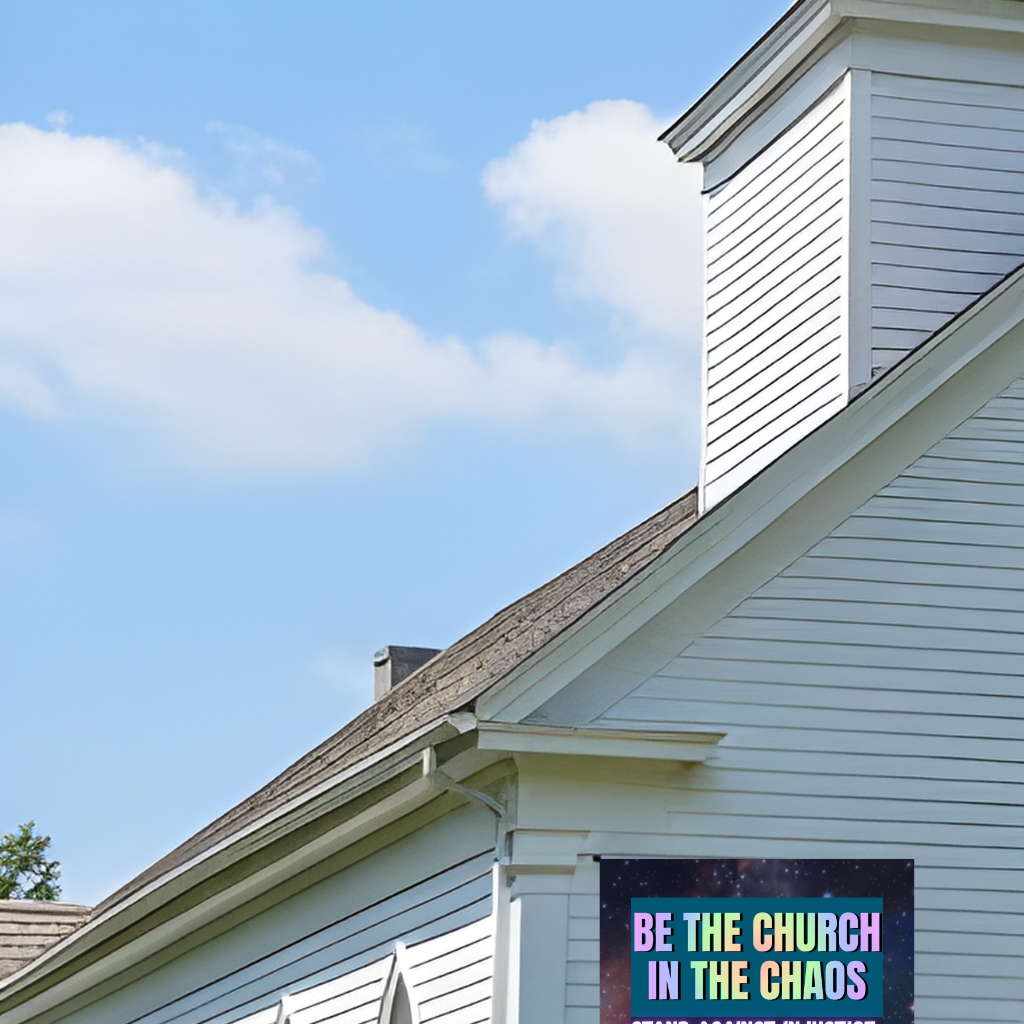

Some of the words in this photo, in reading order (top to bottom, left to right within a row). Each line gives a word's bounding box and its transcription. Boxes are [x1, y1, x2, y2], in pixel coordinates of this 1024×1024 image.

[633, 912, 674, 952] BE
[682, 912, 742, 952] THE
[752, 911, 881, 953] CHURCH
[647, 960, 680, 1001] IN
[690, 960, 750, 1000] THE
[759, 960, 868, 1001] CHAOS
